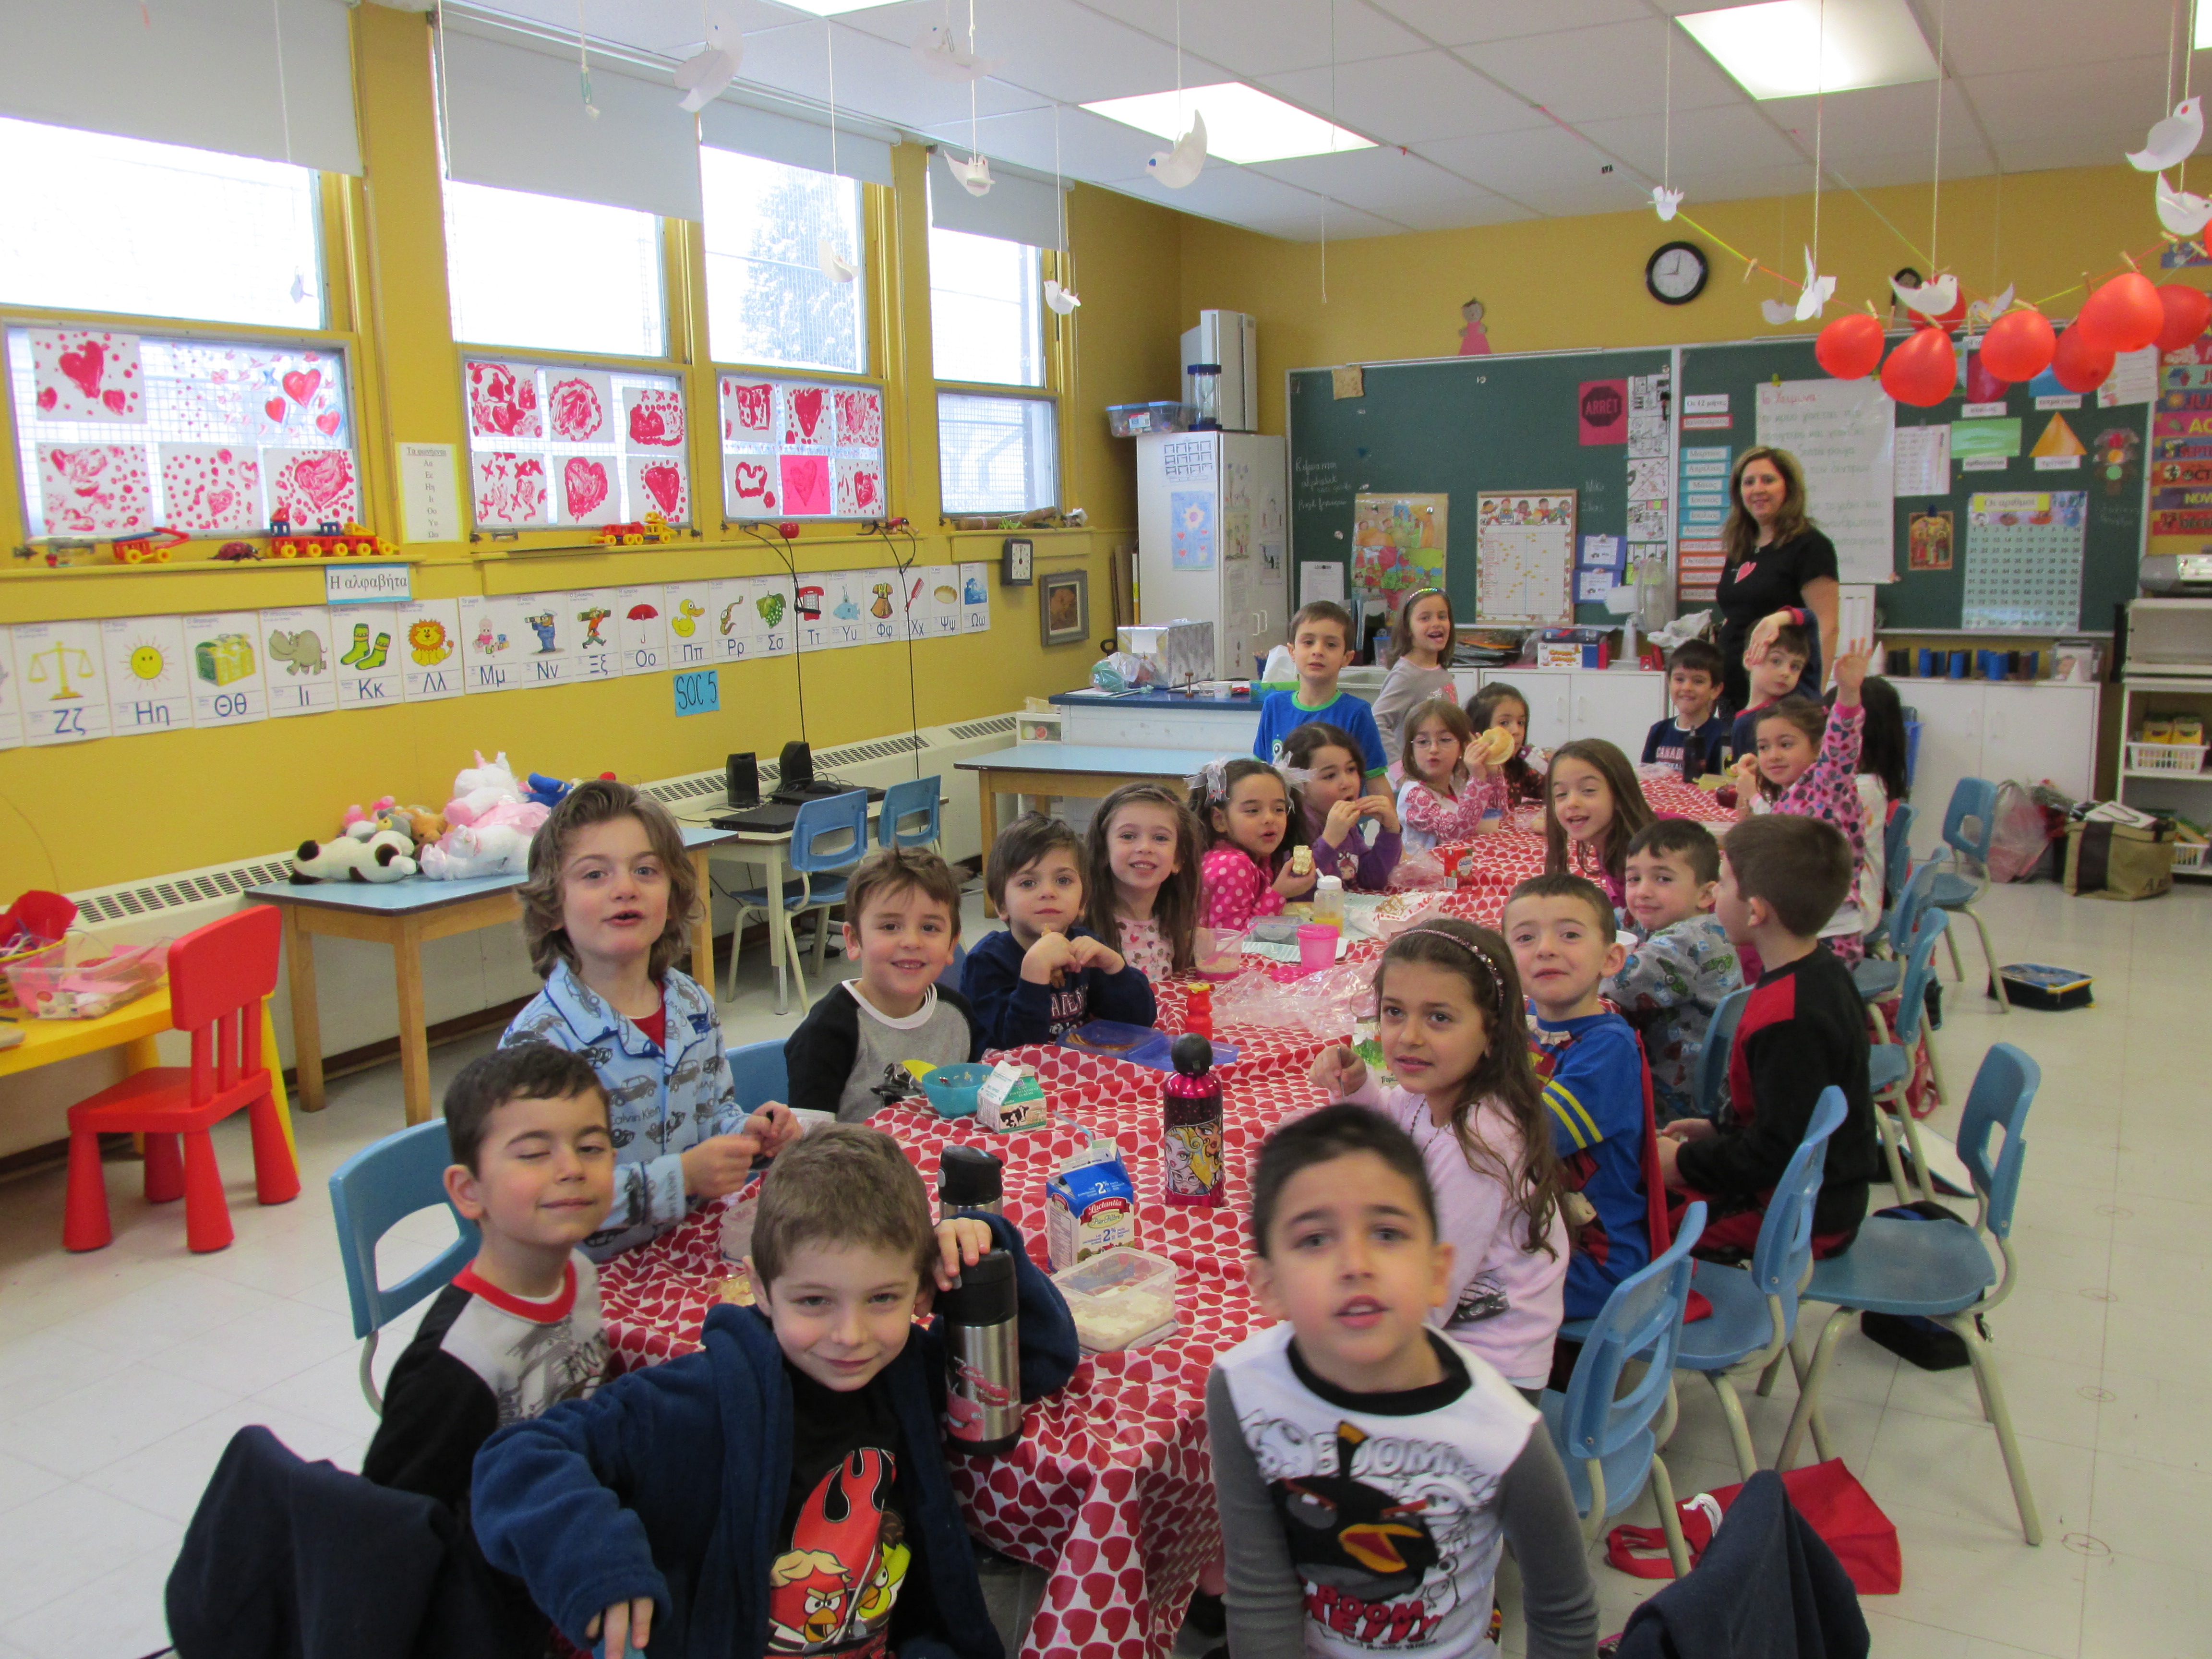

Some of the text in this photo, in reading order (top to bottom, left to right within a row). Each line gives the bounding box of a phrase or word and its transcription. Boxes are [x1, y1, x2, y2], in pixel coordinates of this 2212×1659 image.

[330, 574, 408, 591] Η αλφαβήτα
[911, 619, 925, 637] Χχ
[940, 616, 956, 633] Ψψ
[971, 613, 986, 627] Ωω
[807, 629, 821, 645] Ττ
[842, 625, 857, 642] Υυ
[877, 622, 893, 639] Φφ
[727, 638, 745, 658] Ρρ
[768, 635, 784, 651] Σσ
[636, 650, 656, 667] Οο
[683, 644, 703, 661] Ππ
[537, 661, 558, 680] Νν
[589, 654, 608, 675] Ξξ
[423, 672, 447, 693] Λλ
[480, 665, 505, 687] Μμ
[299, 685, 310, 707] Ιι
[358, 678, 385, 699] Κκ
[676, 671, 717, 709] SOC 5
[134, 701, 170, 726] Ηη
[214, 693, 247, 717] Θθ
[53, 707, 85, 736] Ζζ
[1088, 1199, 1122, 1215] Lactantia
